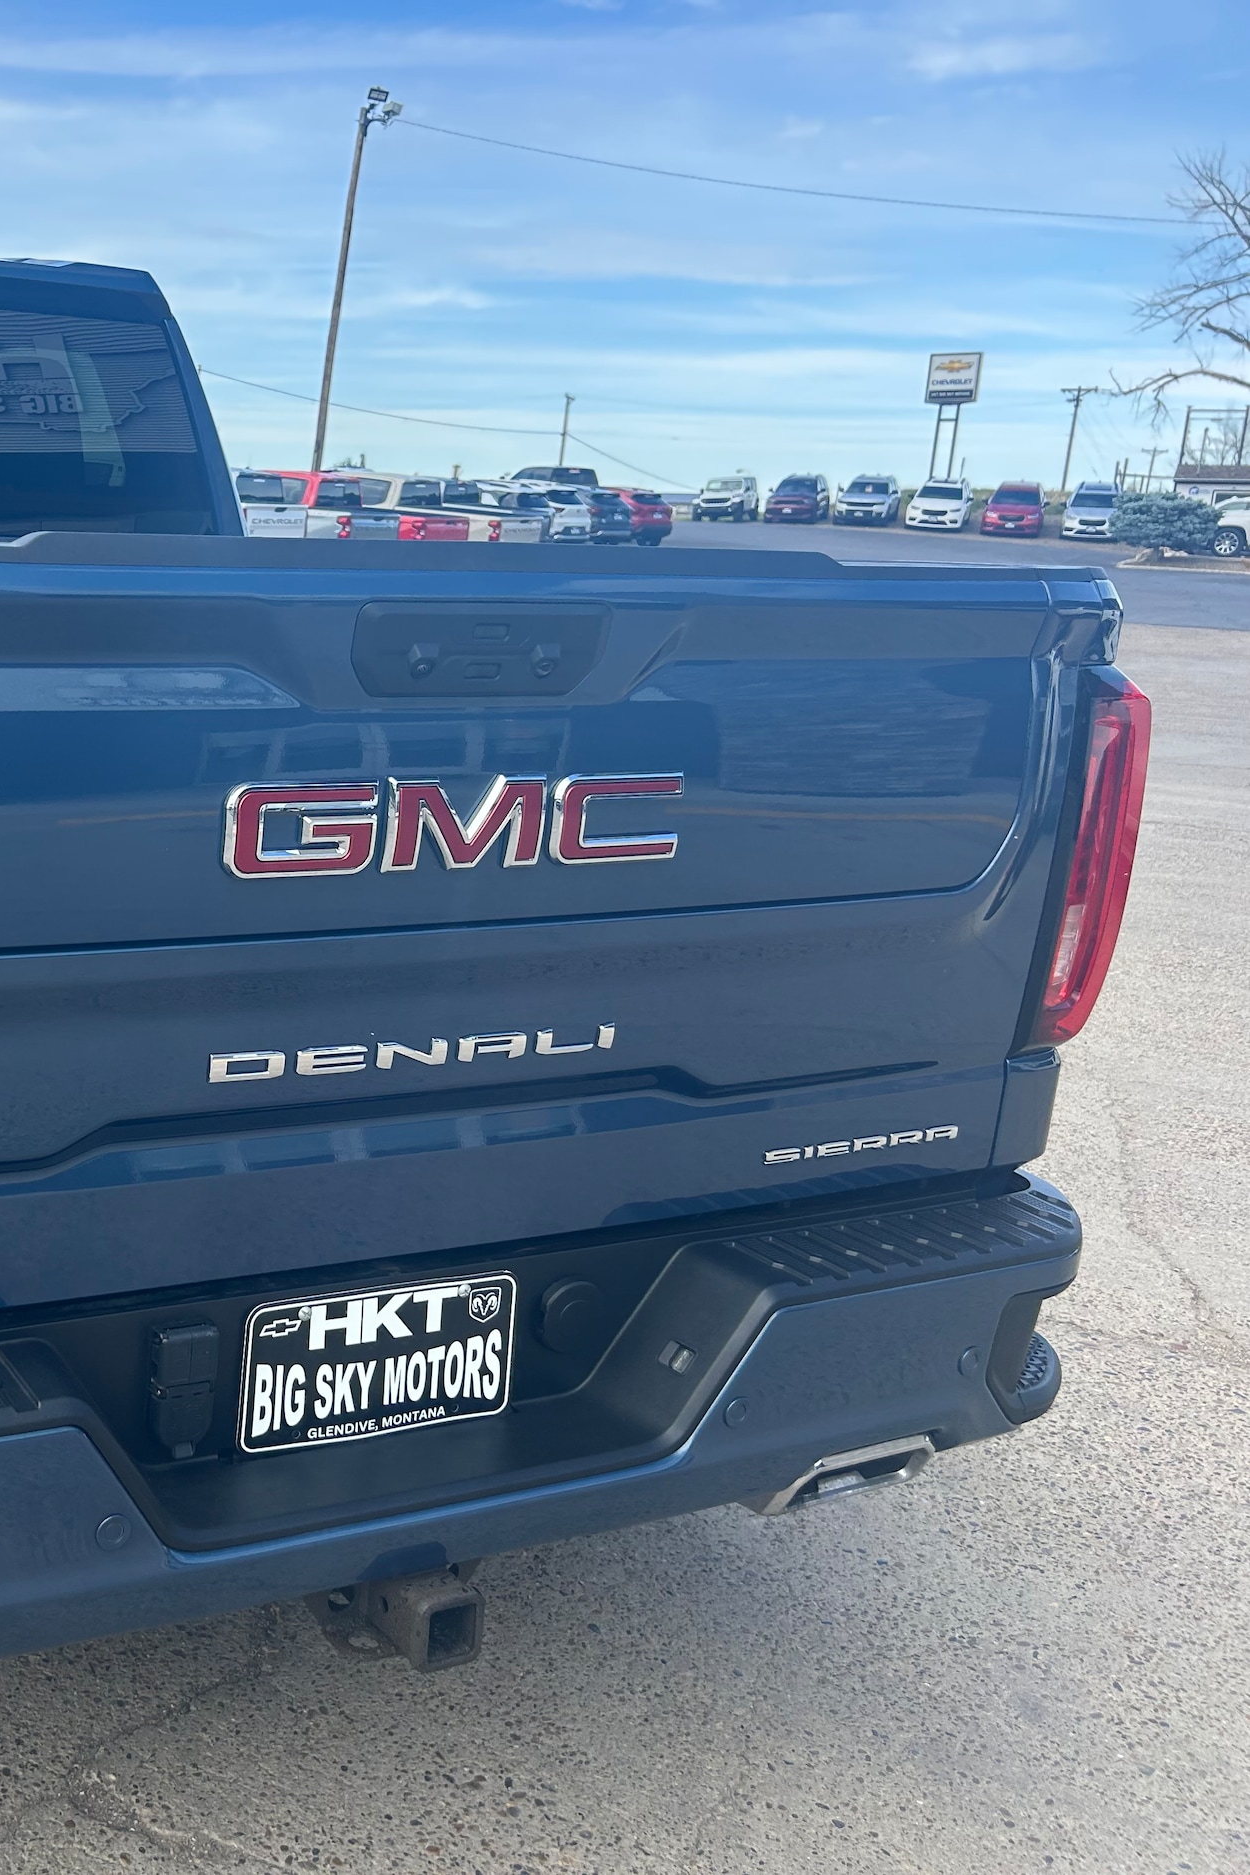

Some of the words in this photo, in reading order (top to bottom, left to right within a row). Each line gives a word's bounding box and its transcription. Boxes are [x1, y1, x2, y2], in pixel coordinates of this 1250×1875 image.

[251, 517, 303, 525] CHEVROLET
[222, 771, 684, 879] GMC
[208, 1022, 615, 1083] DENALI
[763, 1124, 958, 1165] SIERRA
[309, 1286, 459, 1350] HKT
[251, 1363, 306, 1438] BIG
[314, 1360, 377, 1419] SKY
[383, 1329, 502, 1405] MOTORS
[307, 1421, 379, 1439] GLENDIVE,
[382, 1405, 446, 1428] MONTANA
